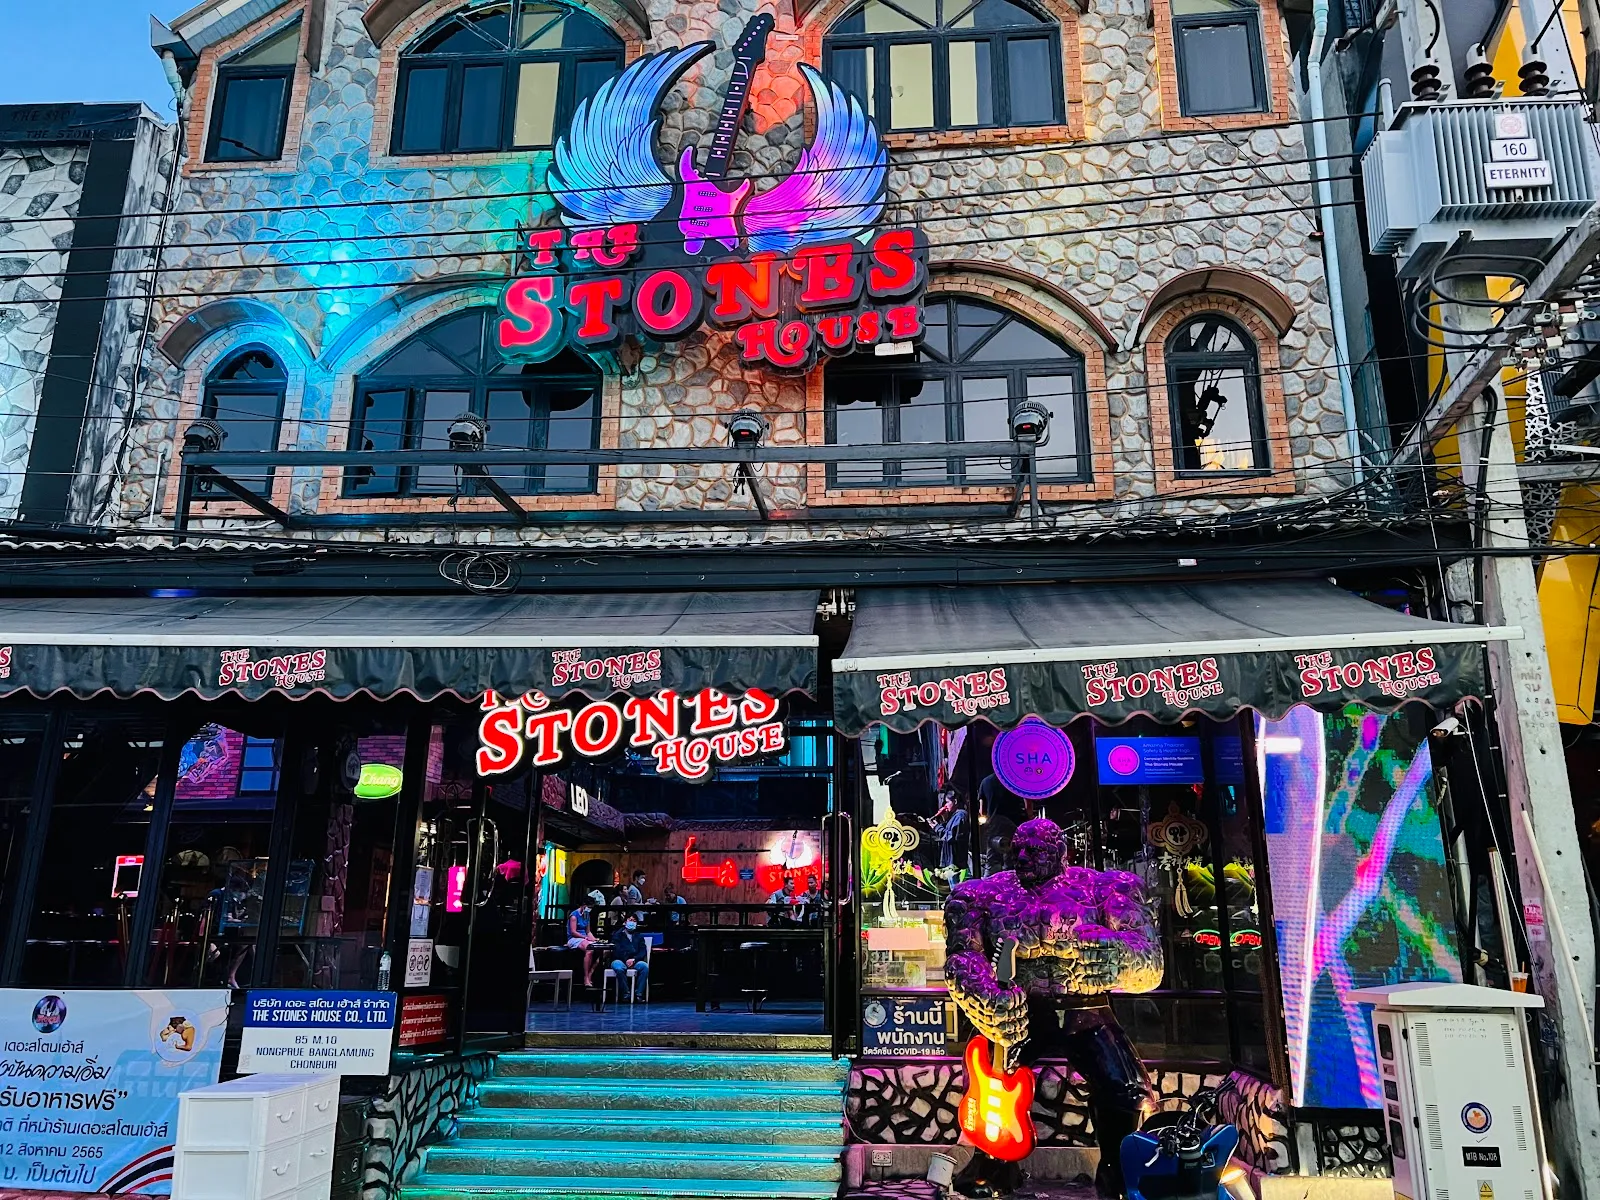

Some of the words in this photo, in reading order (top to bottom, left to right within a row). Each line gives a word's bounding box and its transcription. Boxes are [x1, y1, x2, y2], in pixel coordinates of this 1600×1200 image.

[1501, 142, 1528, 156] 160
[1489, 167, 1547, 180] ETERNITY
[526, 222, 641, 270] THE
[497, 229, 918, 349] STONES
[735, 304, 921, 368] HOUSE
[221, 648, 249, 662] THE
[551, 648, 582, 663] THE
[1294, 650, 1333, 669] THE
[219, 649, 327, 686] STONES
[551, 649, 662, 687] STONES
[1081, 660, 1118, 680] THE
[1300, 646, 1436, 697] STONES
[275, 669, 326, 690] HOUSE
[612, 669, 662, 690] HOUSE
[877, 671, 911, 688] THE
[1085, 657, 1219, 707] STONES
[1378, 672, 1442, 698] HOUSE
[880, 667, 1007, 716] STONES
[1162, 681, 1224, 708] HOUSE
[951, 692, 1011, 717] HOUSE
[476, 686, 780, 778] STONES
[651, 723, 785, 780] HOUSE
[1015, 752, 1052, 764] SHA
[570, 782, 589, 817] LEO
[1195, 933, 1222, 947] OPEN
[1234, 933, 1263, 947] OPEN
[253, 998, 282, 1008] บริษัท
[285, 999, 306, 1008] เดอะ
[308, 998, 335, 1008] สโตน
[363, 998, 390, 1009] จำกัด
[893, 1001, 944, 1025] ร้านนี้
[252, 1009, 269, 1022] THE
[272, 1009, 308, 1022] STONES
[310, 1010, 342, 1022] HOUSE
[344, 1010, 364, 1024] CO.,
[366, 1010, 388, 1023] LTD.
[4, 1037, 85, 1054] เดอะสโตนเฮ้าส์
[312, 1035, 338, 1045] M.10
[877, 1027, 945, 1045] พนักงาน
[256, 1047, 305, 1057] NONGPRUE
[308, 1048, 375, 1058] BANGLAMUNG
[893, 1048, 930, 1056] COVID-19
[290, 1060, 337, 1069] CHONBURI
[18, 1143, 67, 1157] สิงหาคม
[72, 1146, 104, 1159] 2565
[4, 1165, 18, 1181] น.
[26, 1161, 97, 1184] เป็นต้นไป
